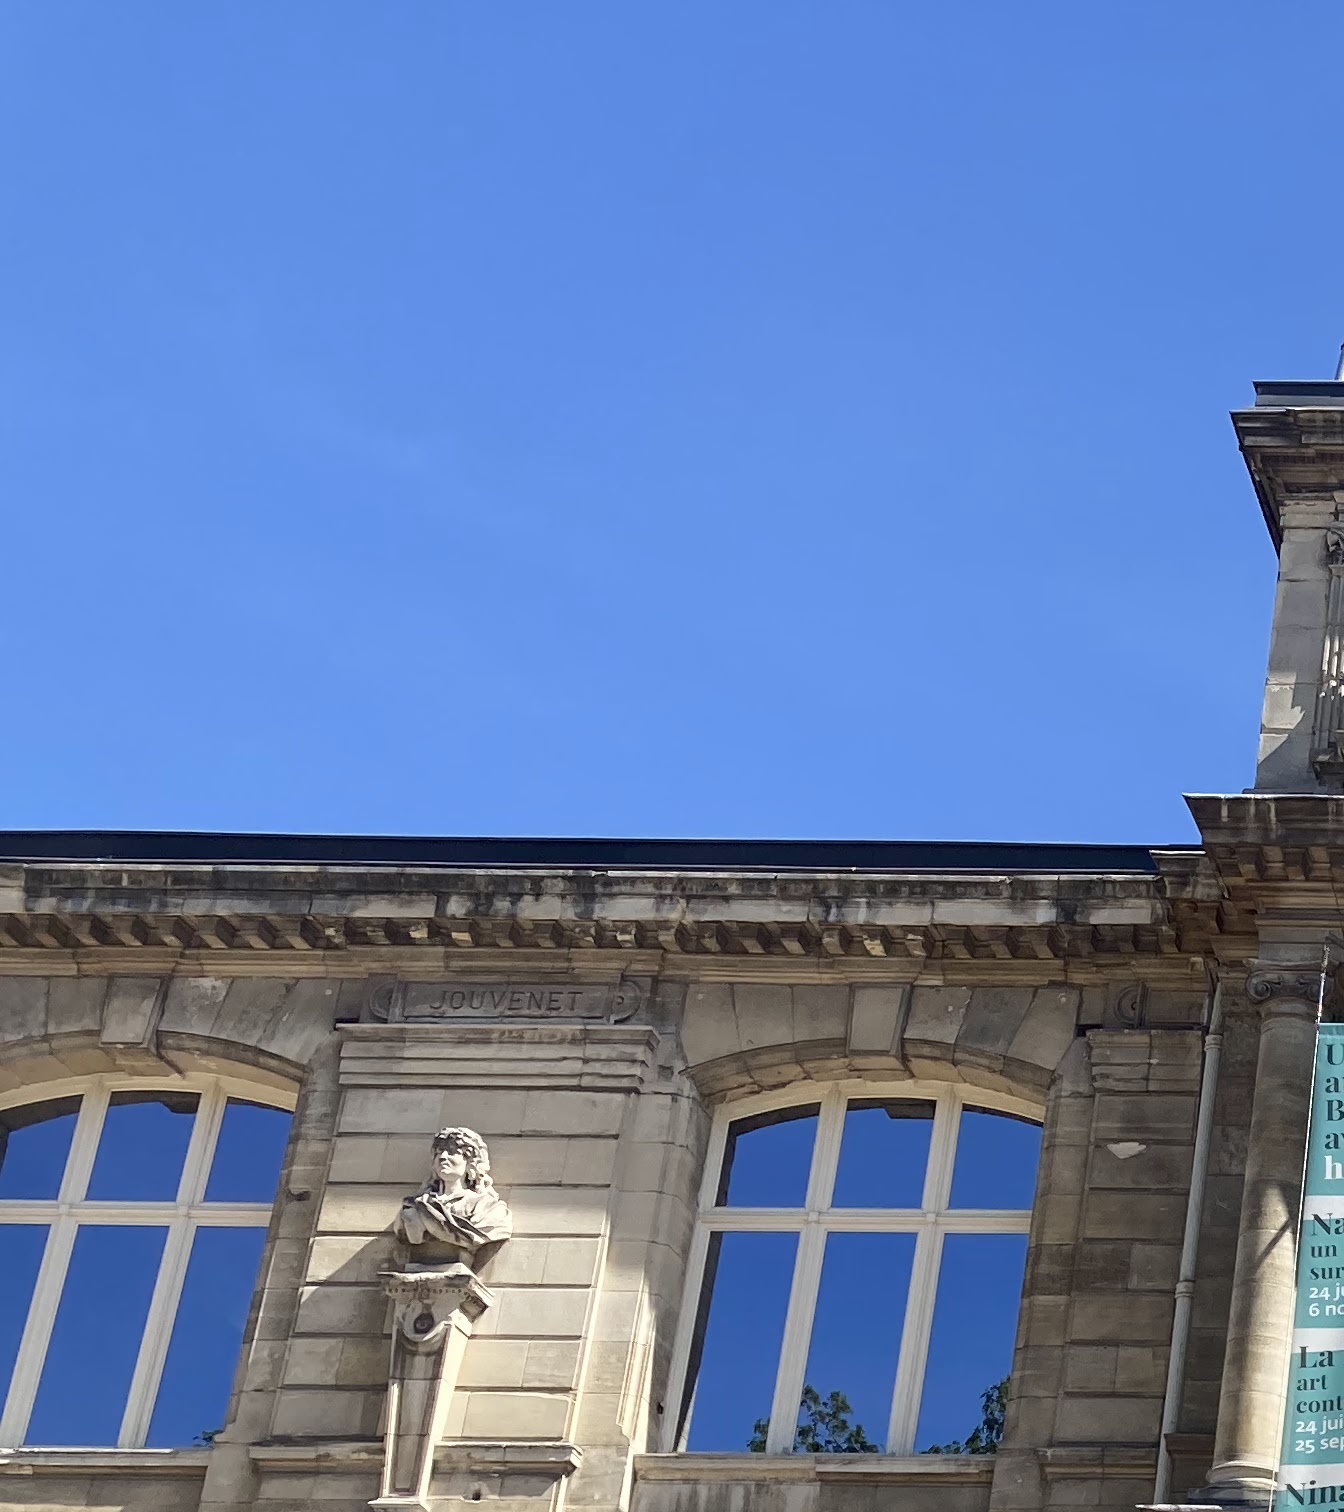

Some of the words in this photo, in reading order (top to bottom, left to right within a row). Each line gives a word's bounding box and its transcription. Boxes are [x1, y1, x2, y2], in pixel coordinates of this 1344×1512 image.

[429, 990, 583, 1012] JOUVENET
[1310, 1242, 1337, 1259] un
[1308, 1286, 1331, 1301] 24
[1308, 1302, 1320, 1317] 6
[1298, 1345, 1334, 1369] La
[1296, 1373, 1328, 1391] art
[1294, 1420, 1317, 1435] 24
[1294, 1437, 1315, 1453] 25
